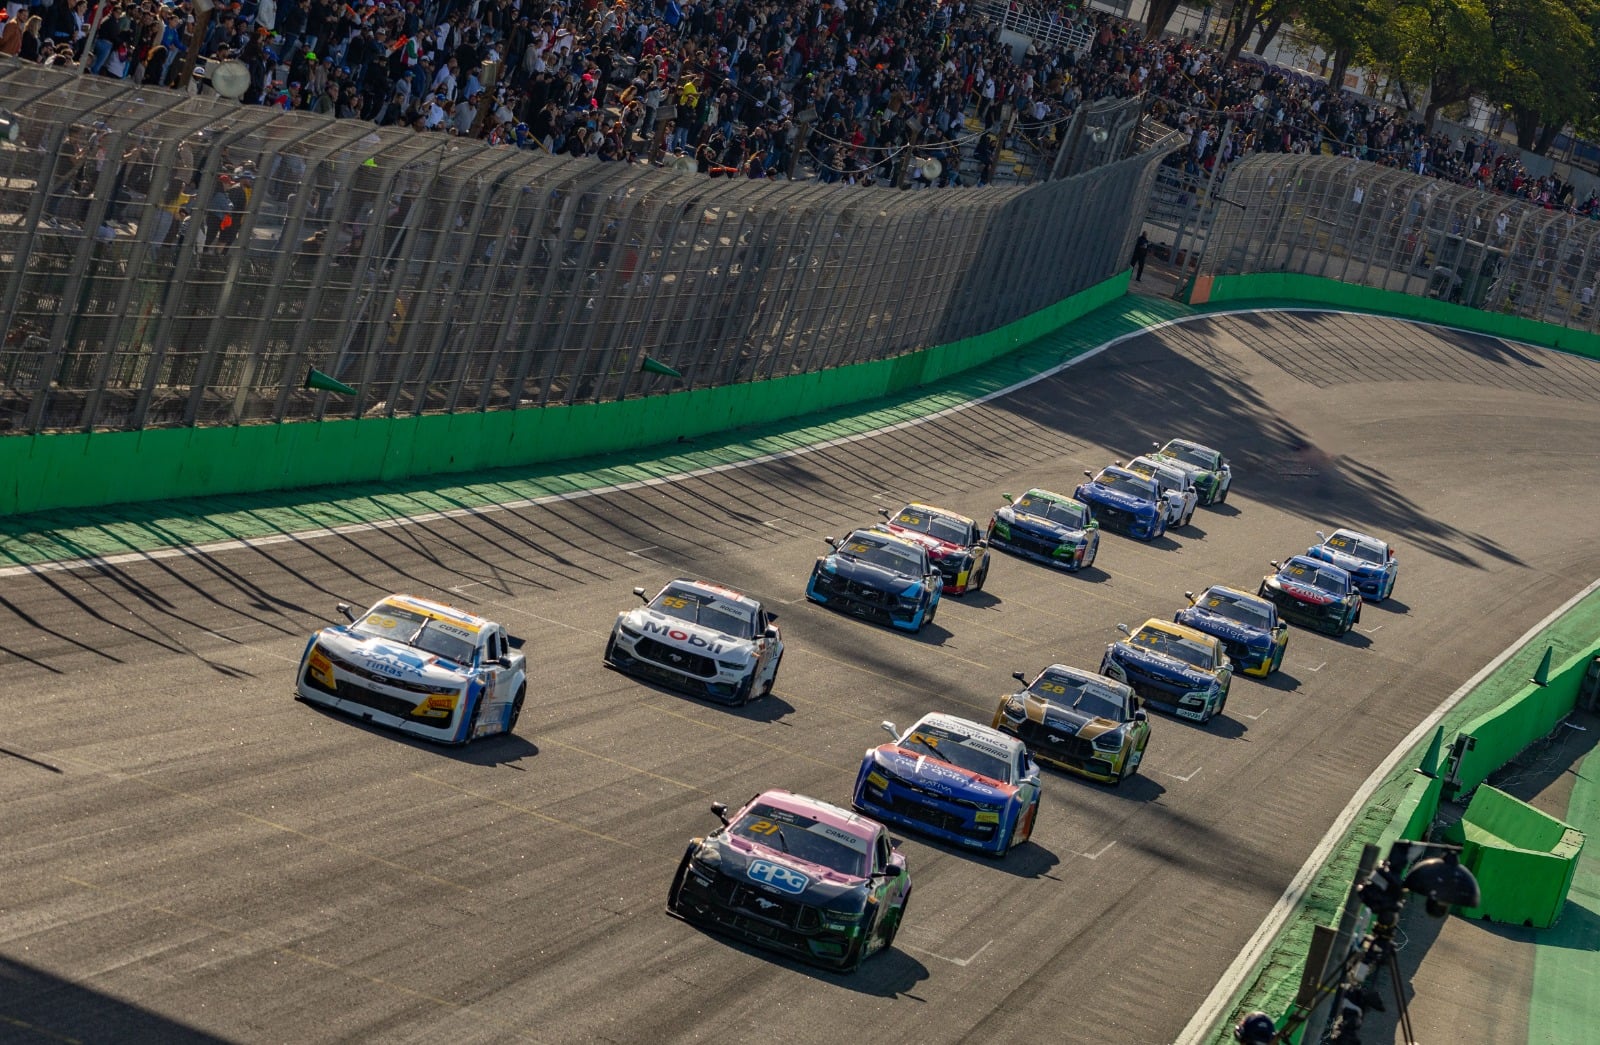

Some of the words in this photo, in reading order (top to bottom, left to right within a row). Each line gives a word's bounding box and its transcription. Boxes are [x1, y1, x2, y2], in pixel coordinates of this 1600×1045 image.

[439, 624, 470, 638] COSTA
[643, 621, 723, 654] Mobil
[366, 660, 403, 677] Tintas
[968, 741, 1009, 759] NAVARRO
[748, 820, 779, 836] 21
[825, 828, 857, 844] CAMILO
[751, 862, 803, 889] PPG
